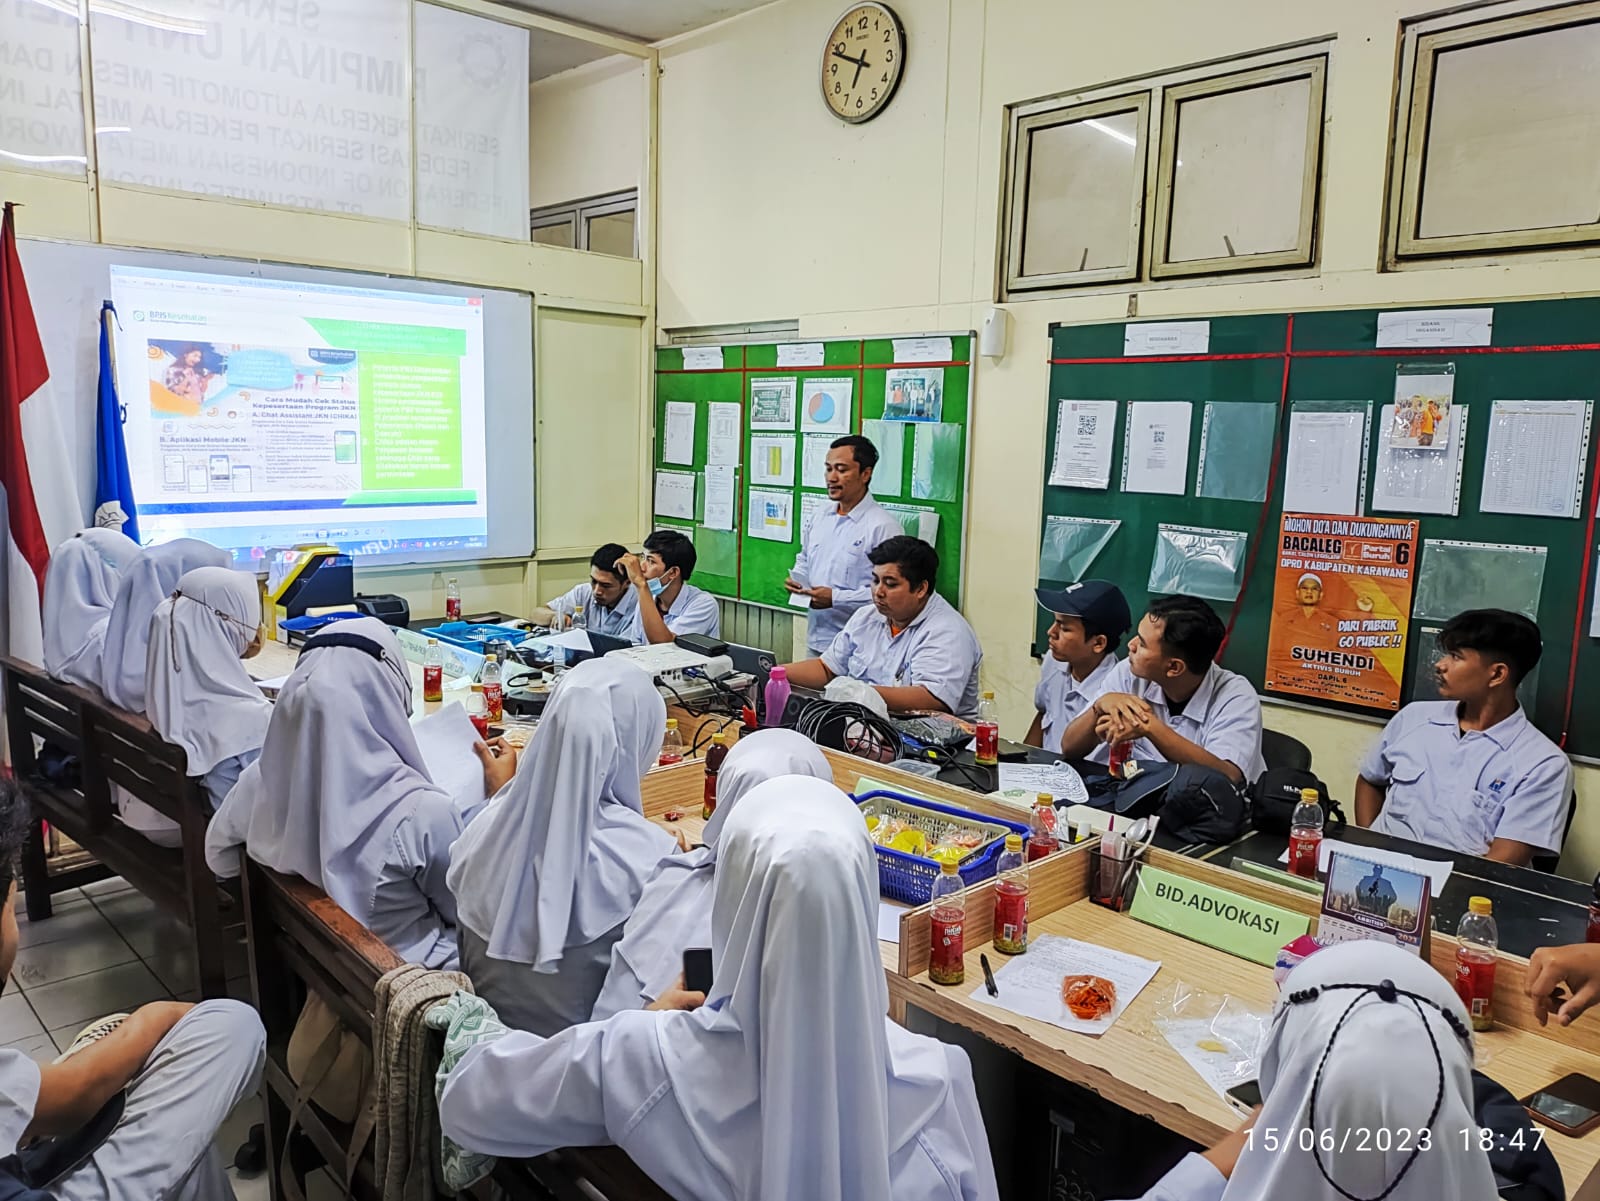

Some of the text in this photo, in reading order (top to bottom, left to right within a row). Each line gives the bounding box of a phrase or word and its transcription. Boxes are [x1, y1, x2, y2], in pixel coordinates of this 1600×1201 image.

[858, 16, 868, 30] 12
[874, 18, 878, 31] 1
[845, 26, 854, 39] 11
[884, 30, 890, 42] 2
[886, 50, 894, 62] 3
[831, 64, 838, 76] 9
[881, 72, 888, 82] 4
[834, 82, 842, 94] 8
[870, 88, 878, 100] 5
[844, 93, 850, 106] 7
[856, 96, 864, 108] 6
[170, 436, 202, 444] Aplikasi
[1284, 517, 1311, 532] MOHON
[1332, 521, 1348, 535] DAN
[1350, 522, 1412, 540] DUKUNGANNYA
[1283, 535, 1342, 554] BACALEG
[1363, 544, 1391, 552] Partai
[1363, 552, 1391, 560] Buruh
[1395, 542, 1410, 565] 6
[1281, 558, 1408, 579] DPRD KABUPATEN KARAWANG
[1338, 619, 1398, 632] DARI PABRIK
[1338, 636, 1354, 648] GO
[1356, 636, 1389, 648] PUBLIC
[1291, 647, 1374, 670] SUHENDI
[1302, 663, 1361, 677] AKTIVIS BURUH
[1318, 673, 1340, 682] DAPIL
[1155, 882, 1280, 935] BID.ADVOKASI
[1357, 916, 1384, 928] AMBITION
[1397, 933, 1418, 944] 2023
